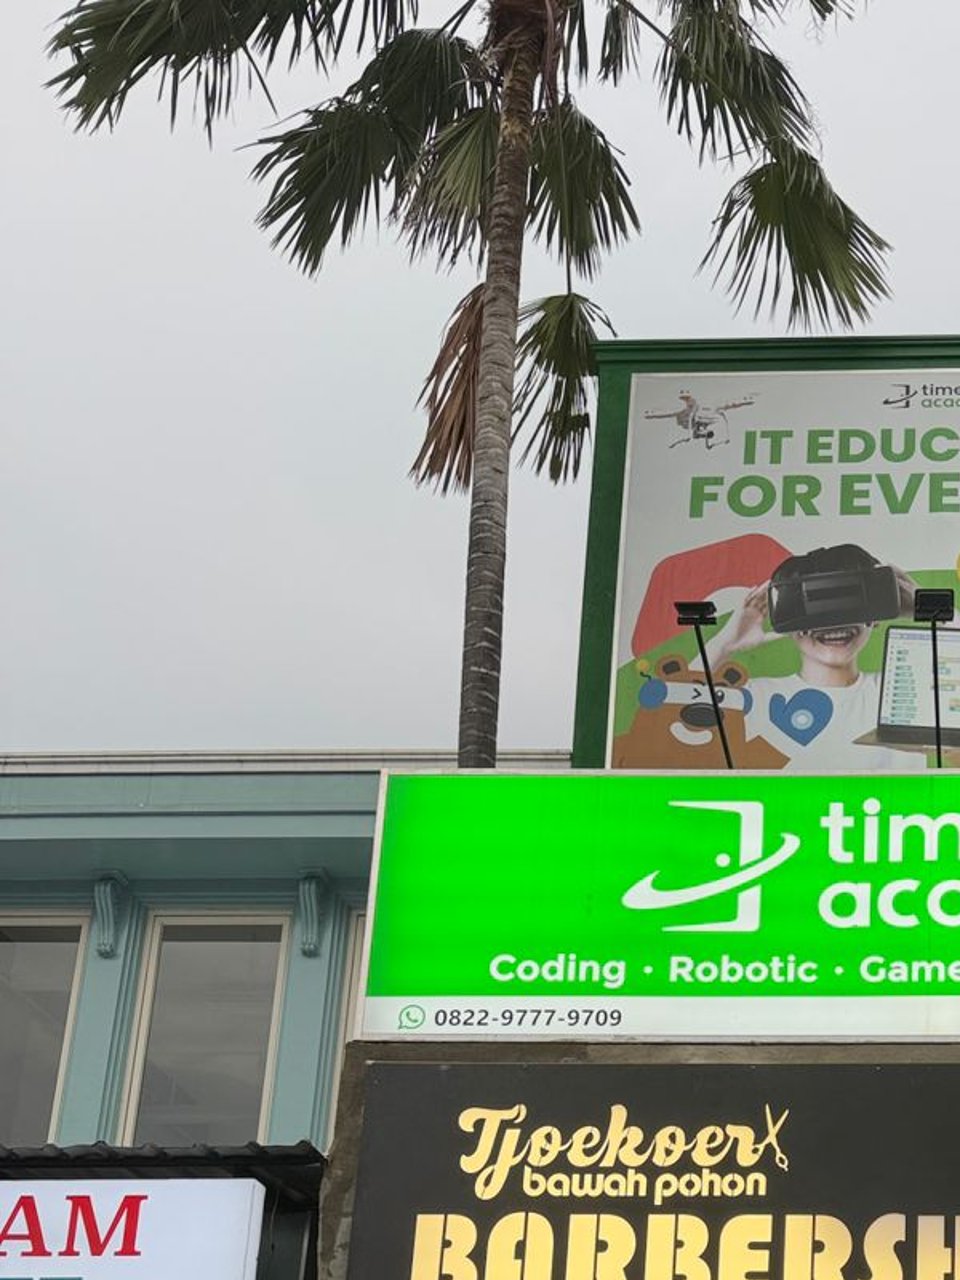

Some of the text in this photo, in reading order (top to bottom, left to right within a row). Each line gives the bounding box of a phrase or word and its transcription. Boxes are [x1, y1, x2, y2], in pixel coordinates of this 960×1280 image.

[743, 429, 795, 466] IT
[689, 474, 821, 519] FOR
[488, 953, 626, 989] Coding
[668, 954, 818, 983] Robotic
[434, 1008, 622, 1027] 0822-9777-9709
[458, 1103, 762, 1200] Tjoekoer
[522, 1166, 767, 1206] bawah pohon
